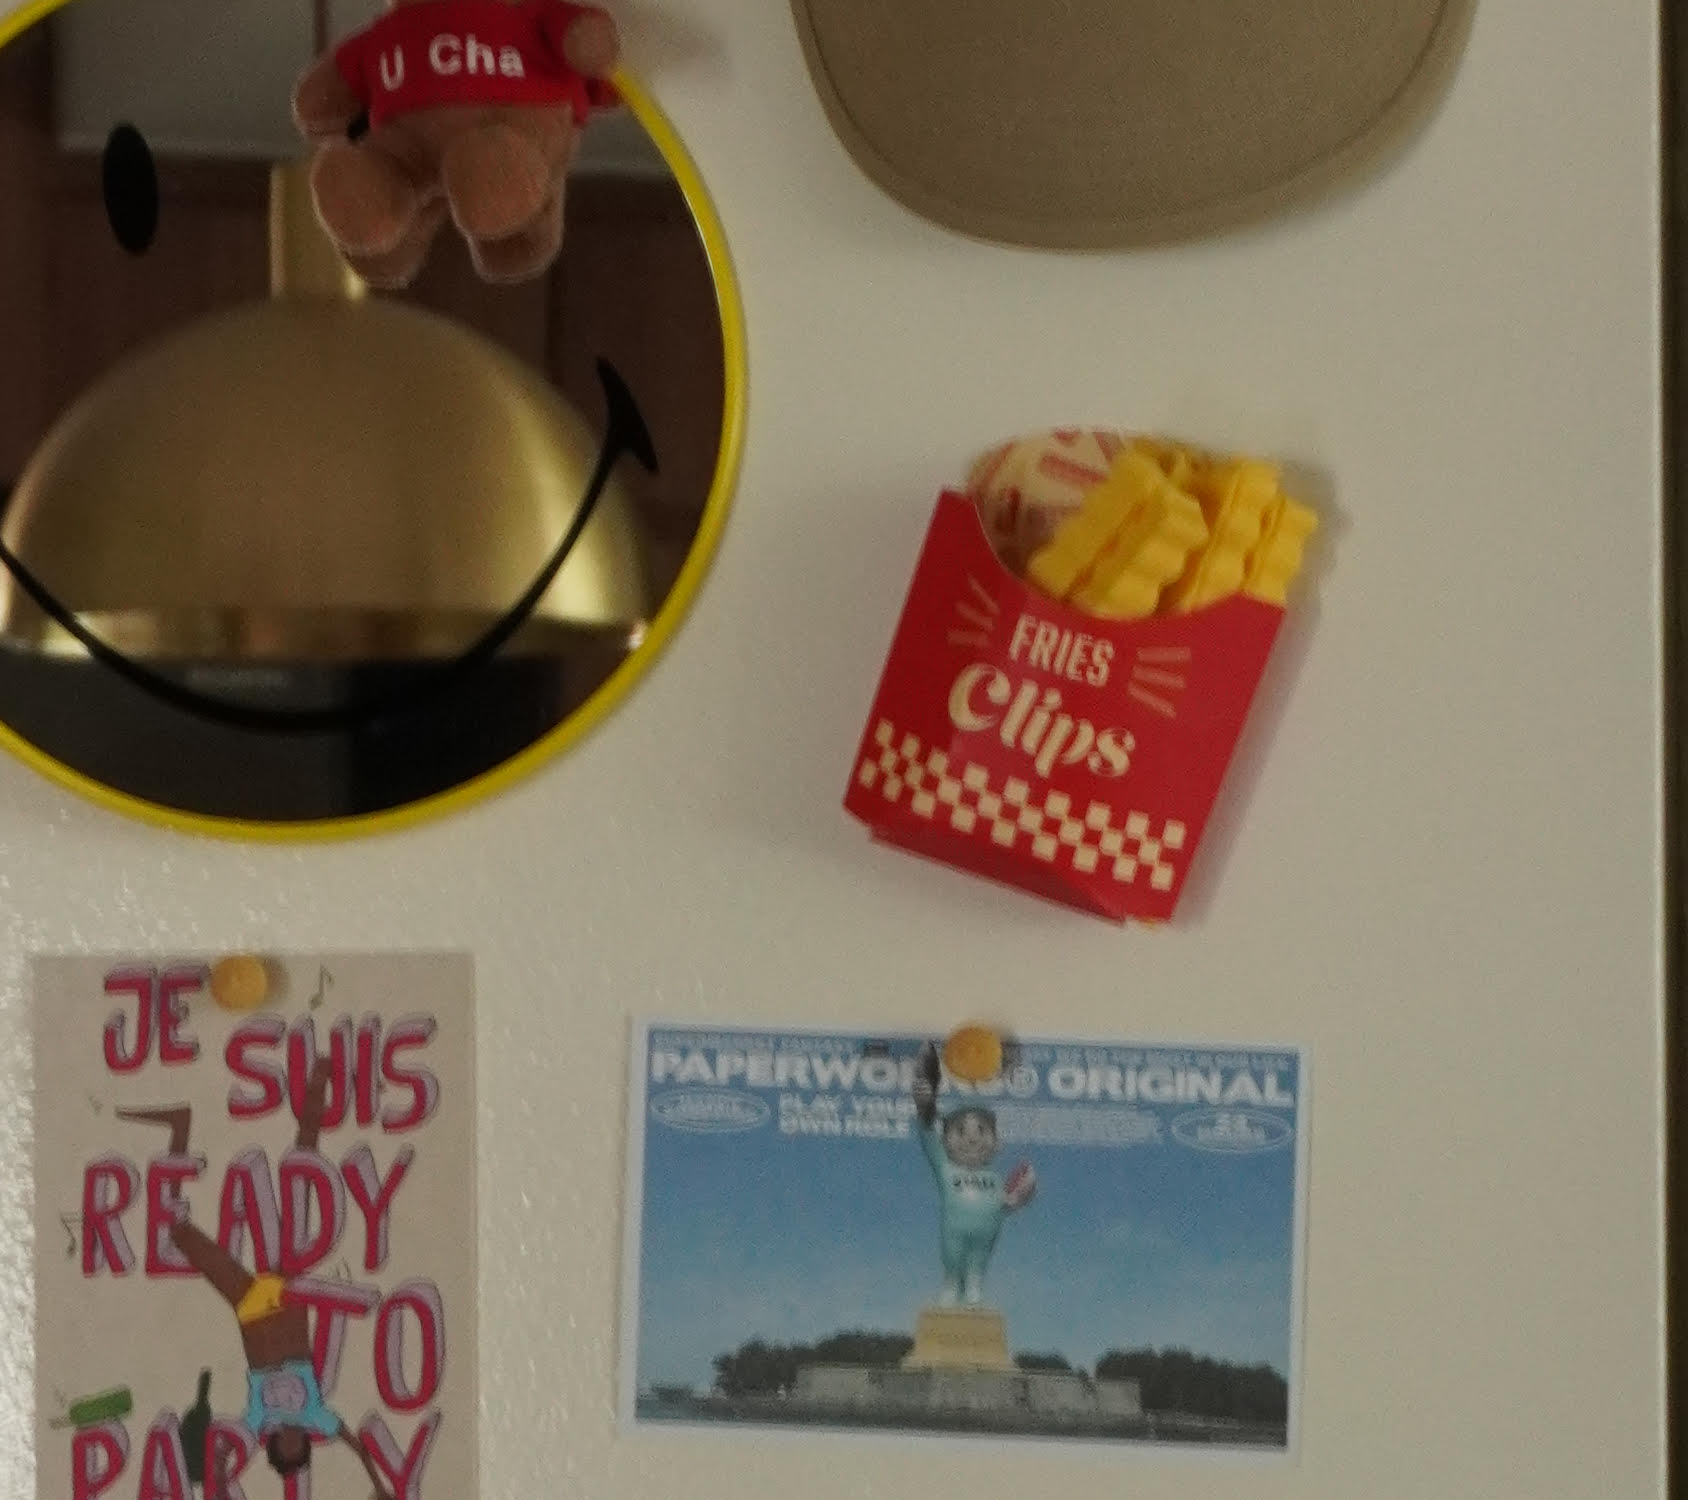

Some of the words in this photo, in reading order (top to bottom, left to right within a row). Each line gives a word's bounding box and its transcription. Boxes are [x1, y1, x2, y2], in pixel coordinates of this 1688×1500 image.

[428, 33, 527, 80] Cha
[1009, 613, 1116, 688] FRIES
[947, 662, 1137, 779] Clips
[102, 962, 212, 1074] JE
[223, 1010, 441, 1134] SUIS
[1047, 1063, 1295, 1109] ORIGINAL
[79, 1143, 416, 1279] READY
[281, 1272, 448, 1412] TO
